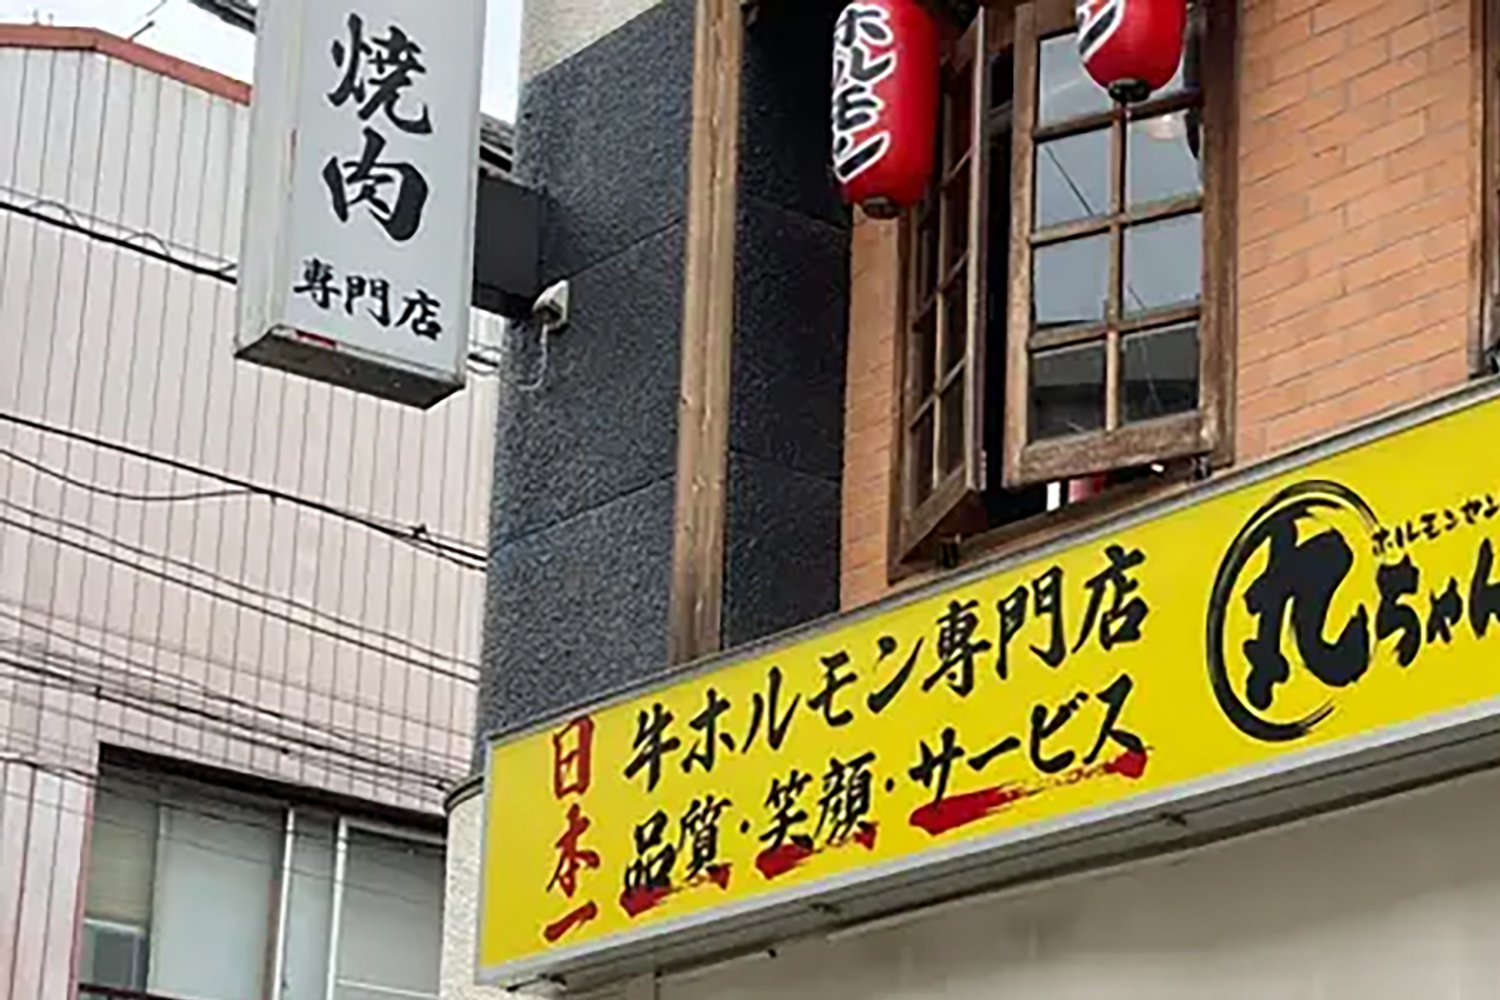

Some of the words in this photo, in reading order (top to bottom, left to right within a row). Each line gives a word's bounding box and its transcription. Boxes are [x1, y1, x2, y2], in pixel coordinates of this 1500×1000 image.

[322, 13, 432, 241] 焼肉
[293, 257, 442, 342] 専門店
[624, 544, 1149, 790] 牛ホルモン専門店
[543, 715, 599, 942] 日本一
